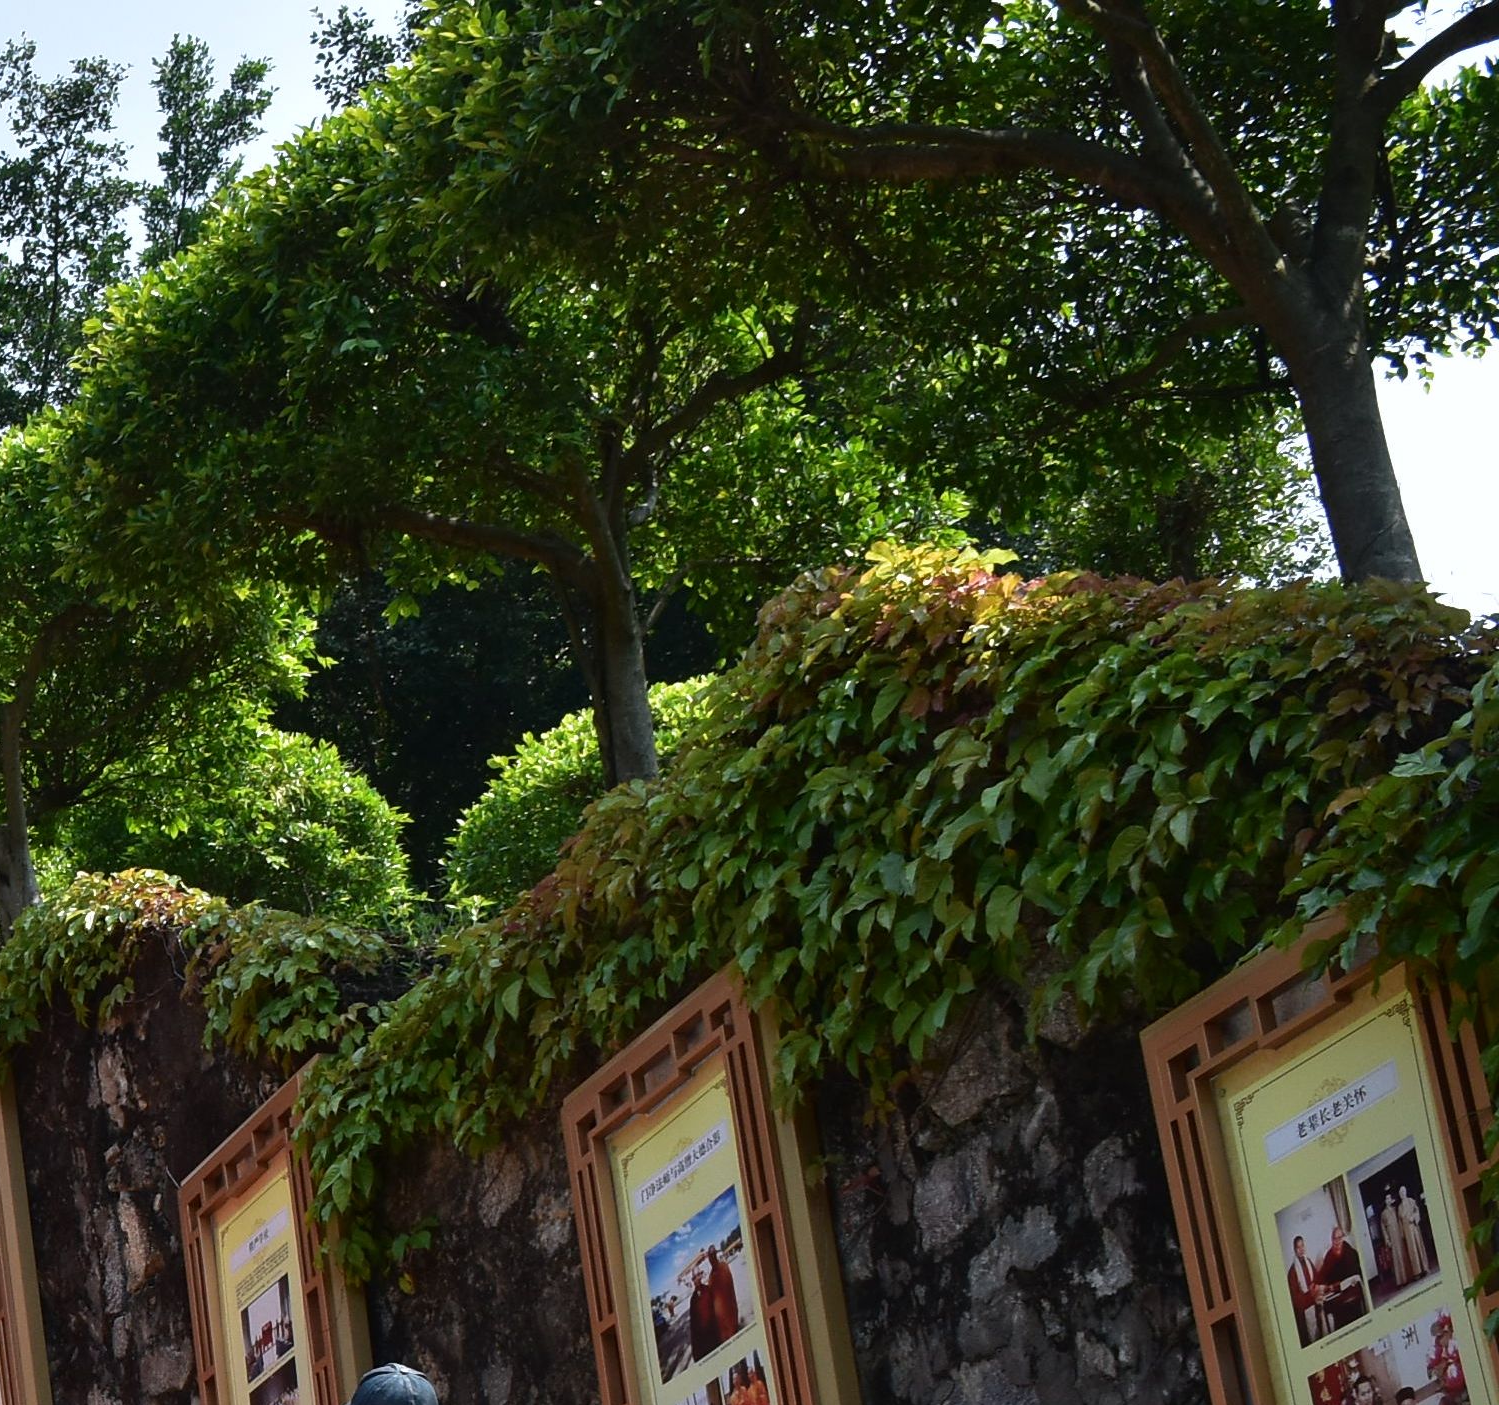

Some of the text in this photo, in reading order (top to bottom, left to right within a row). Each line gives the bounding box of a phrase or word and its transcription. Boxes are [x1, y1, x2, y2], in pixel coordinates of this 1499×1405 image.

[1296, 1084, 1368, 1139] 老辈长老关怀
